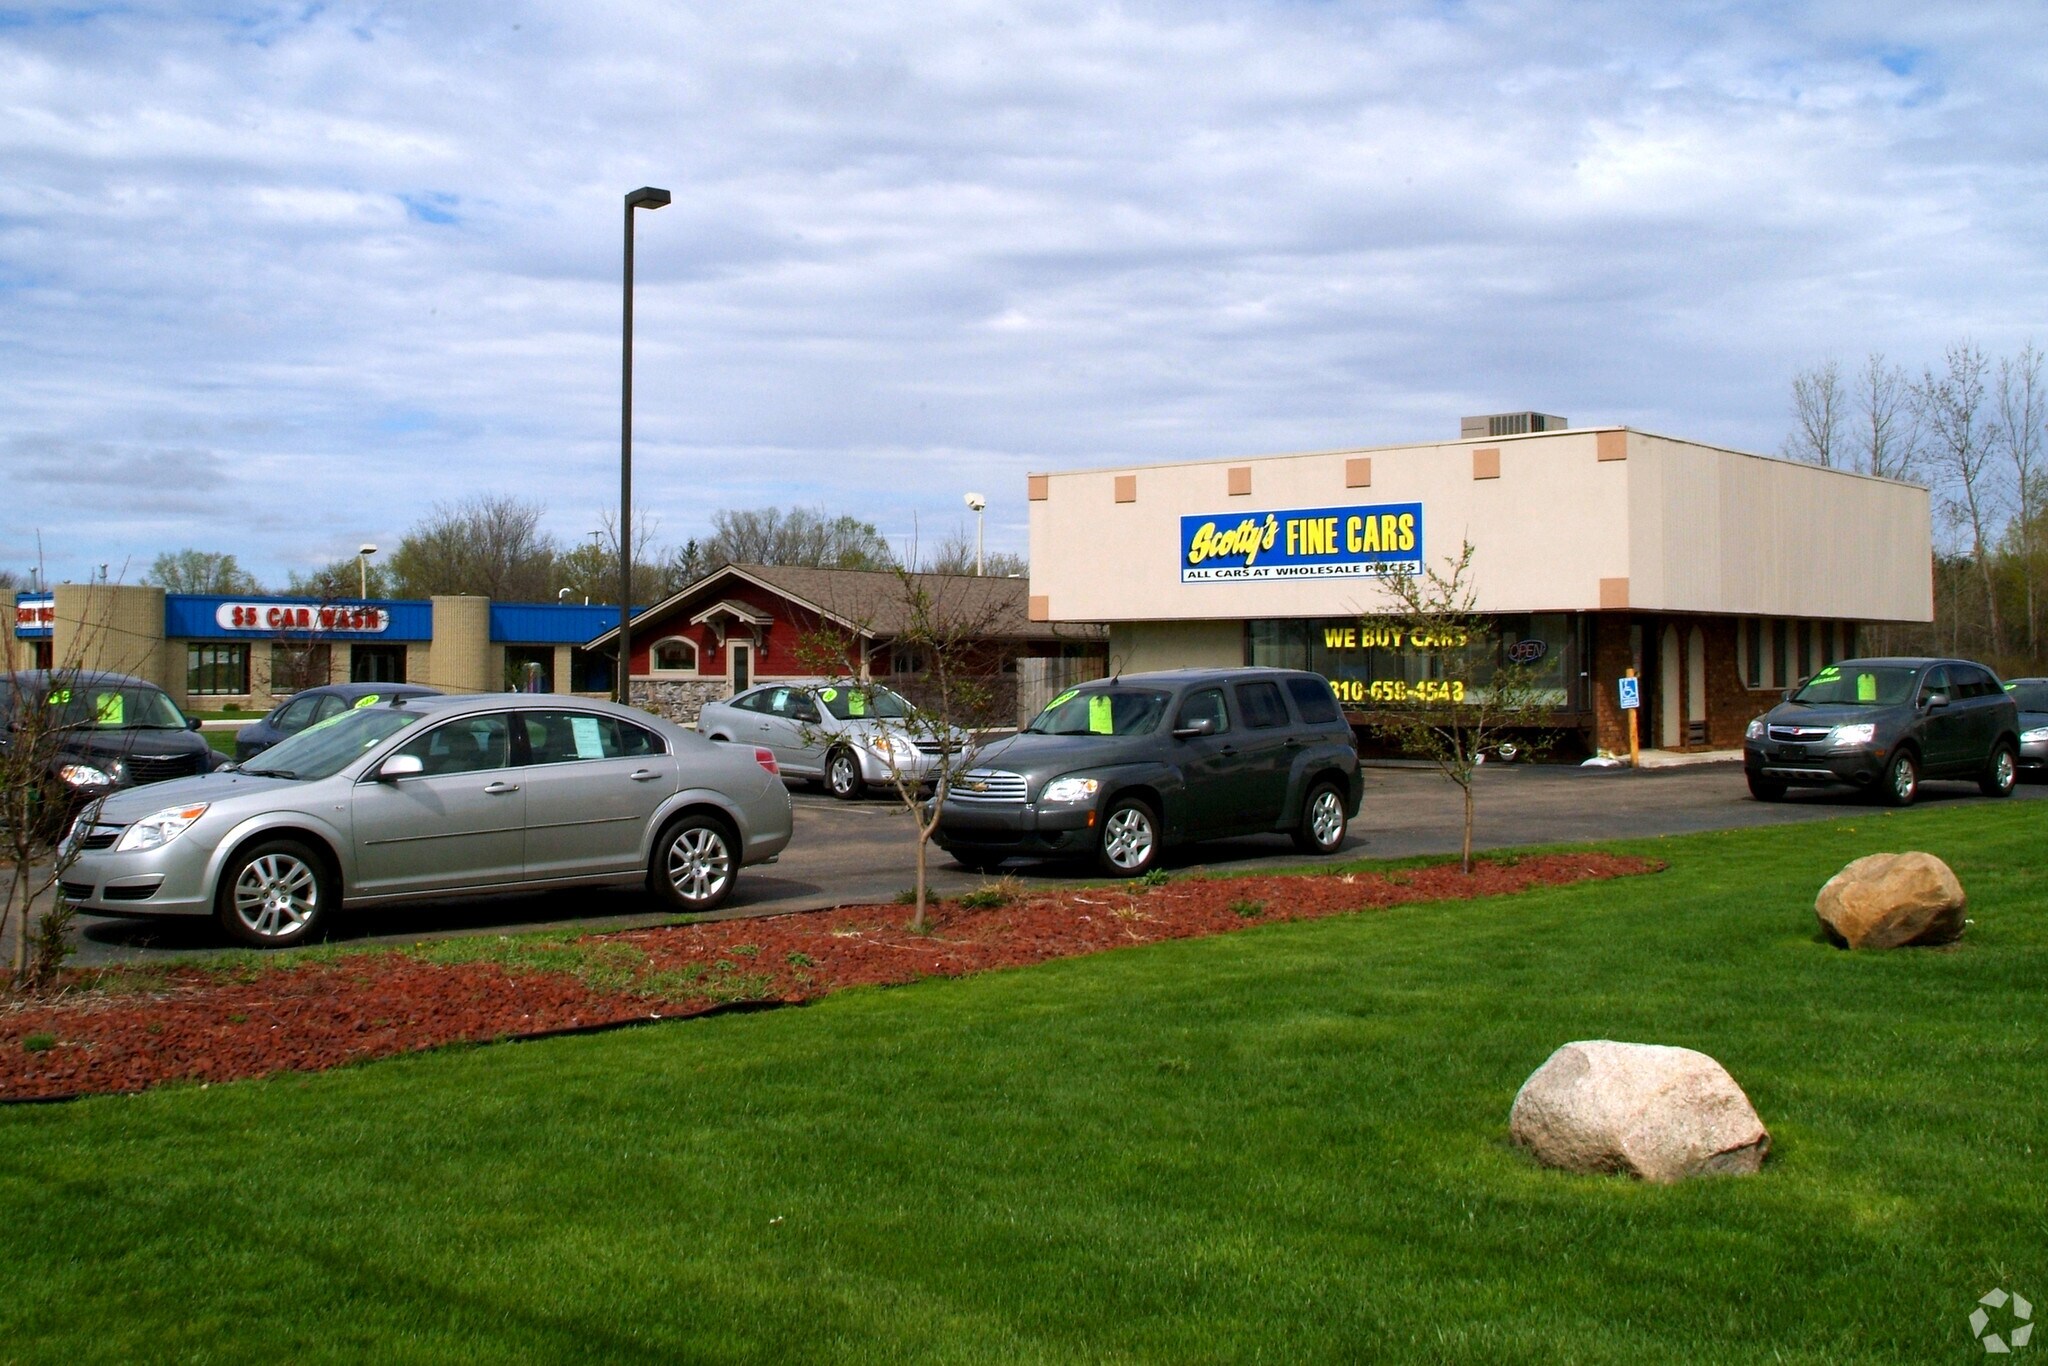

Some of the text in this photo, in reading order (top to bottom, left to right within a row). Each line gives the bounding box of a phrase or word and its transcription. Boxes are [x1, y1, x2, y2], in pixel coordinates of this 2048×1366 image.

[1187, 513, 1415, 566] Scotty's FINE CARS
[1187, 569, 1211, 579] ALL
[1214, 568, 1250, 578] CARS
[1253, 568, 1269, 577] AT
[1276, 564, 1360, 576] WHOLESALE
[231, 605, 379, 629] $5 CAR WASH
[1324, 626, 1468, 648] WE BUY CARS
[1510, 643, 1542, 658] OPEN
